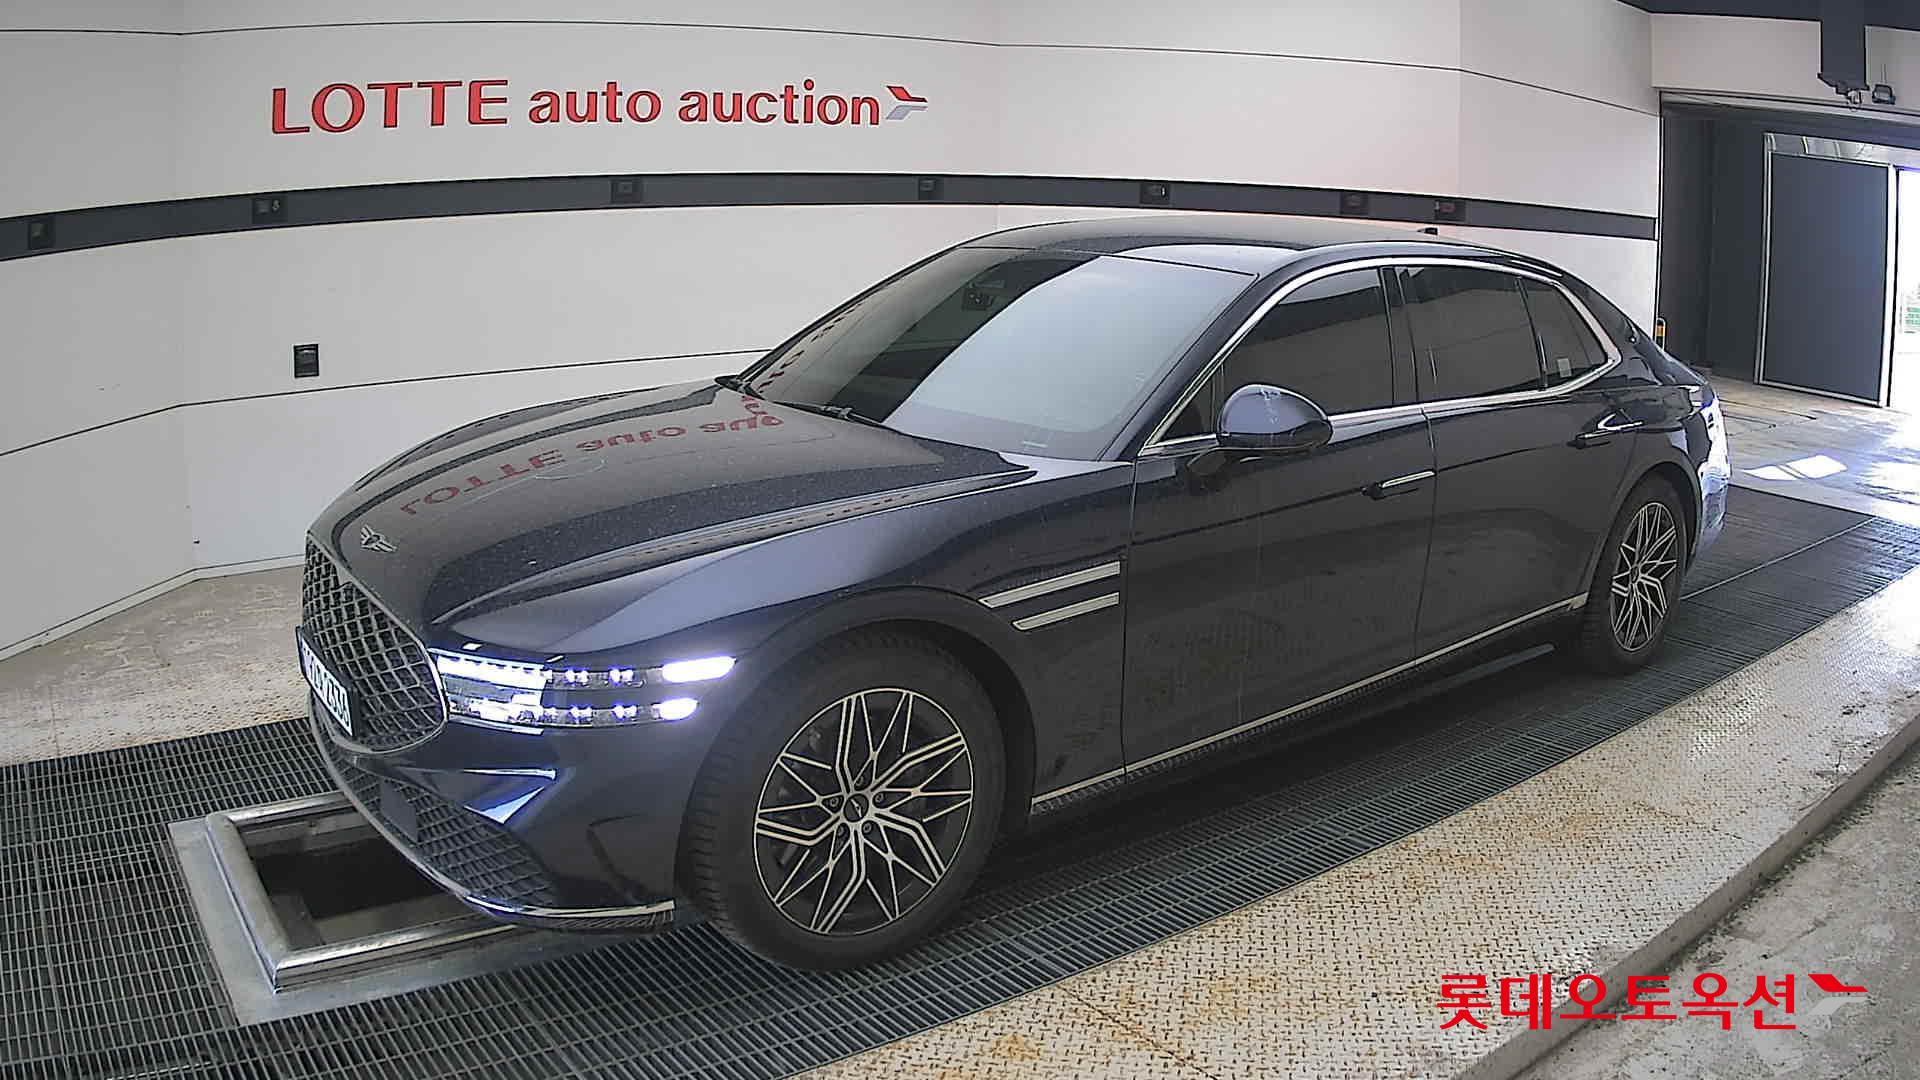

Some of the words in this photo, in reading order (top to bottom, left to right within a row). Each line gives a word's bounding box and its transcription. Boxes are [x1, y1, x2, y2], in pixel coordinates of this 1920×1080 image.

[271, 79, 508, 135] LOTTE
[528, 80, 663, 124] auto
[677, 78, 881, 127] auction
